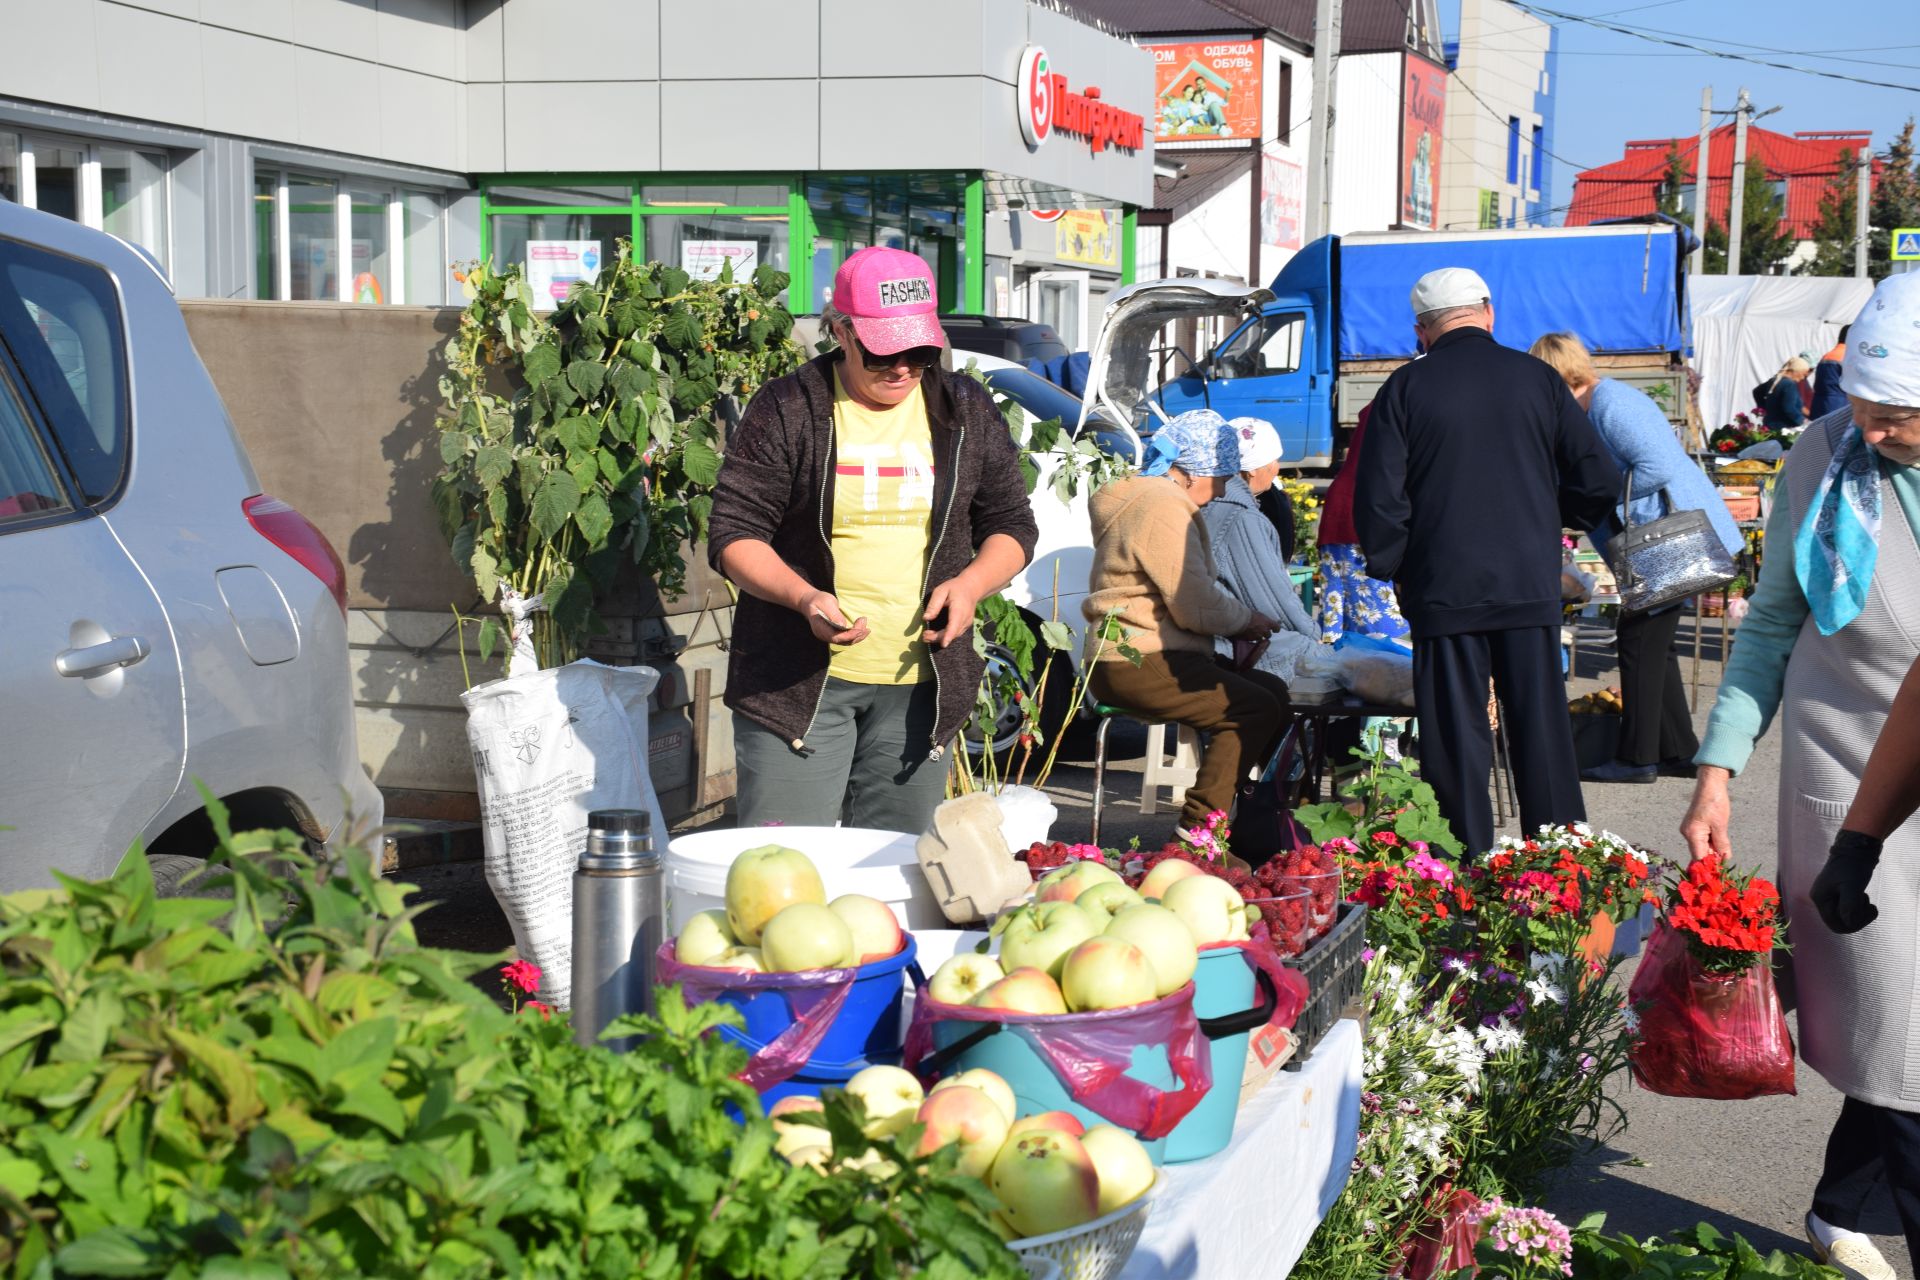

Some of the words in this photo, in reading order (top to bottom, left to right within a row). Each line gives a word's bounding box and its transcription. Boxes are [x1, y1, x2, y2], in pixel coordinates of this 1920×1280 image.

[1154, 50, 1176, 62] ОМ
[1203, 44, 1254, 57] ОДЕЖДА
[1212, 57, 1253, 69] ОБУВЬ
[1051, 73, 1145, 153] Пятёрочка
[880, 279, 931, 306] FASHION
